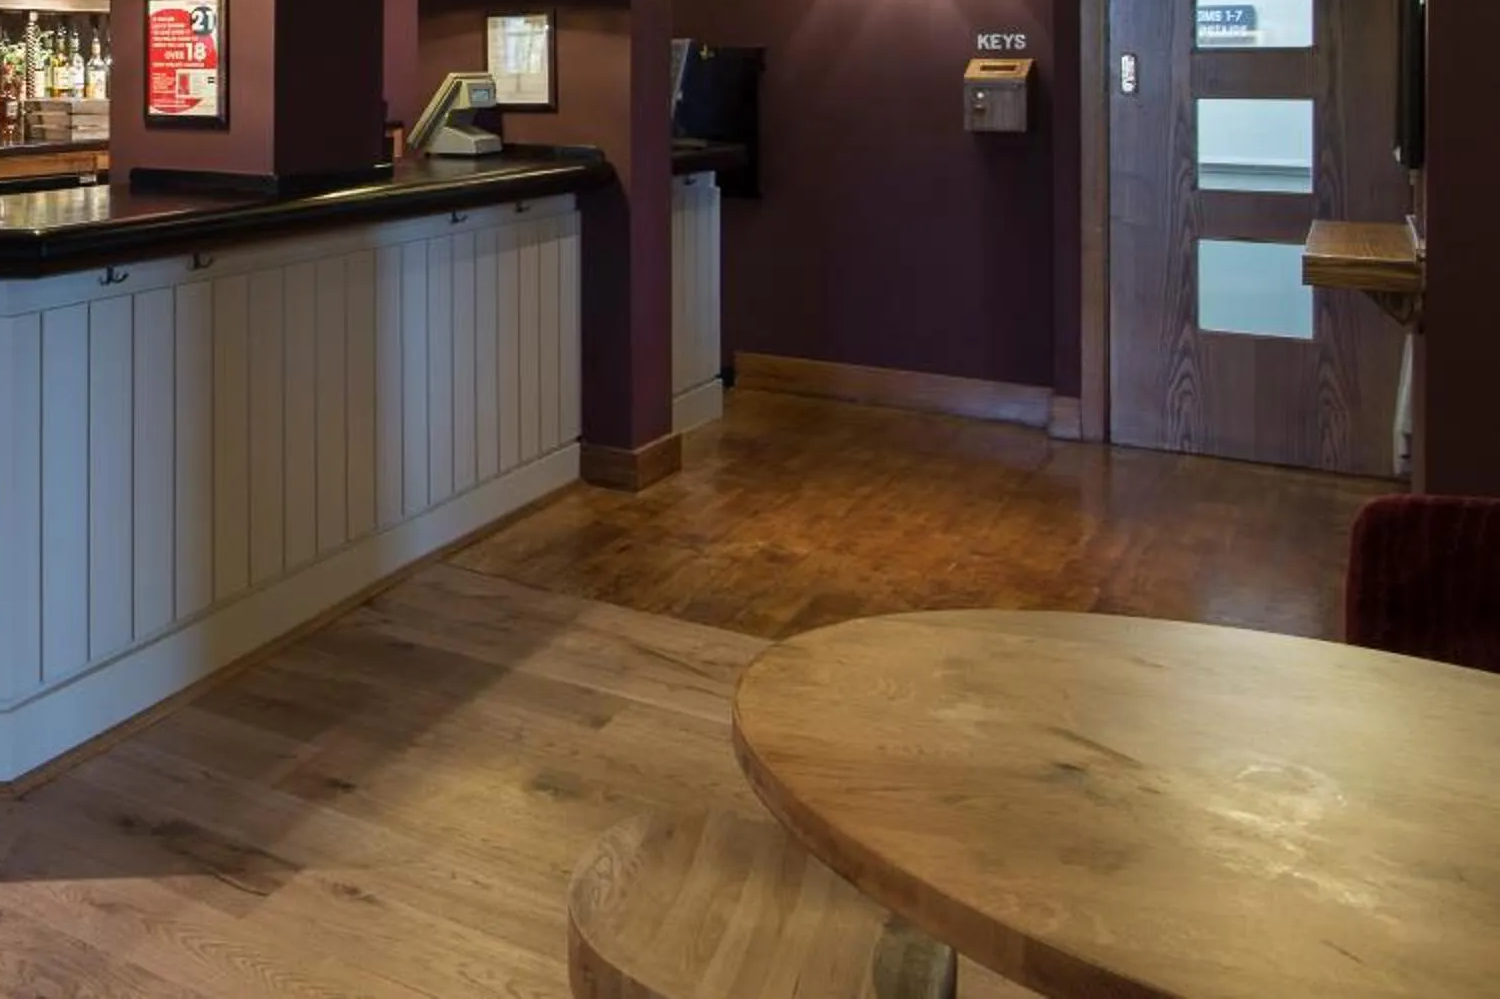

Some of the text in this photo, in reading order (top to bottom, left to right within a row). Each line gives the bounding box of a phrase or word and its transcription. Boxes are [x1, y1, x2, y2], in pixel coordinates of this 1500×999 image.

[191, 10, 214, 31] 21
[1226, 10, 1243, 22] 1-7
[977, 33, 1026, 50] KEYS
[186, 42, 206, 62] 18
